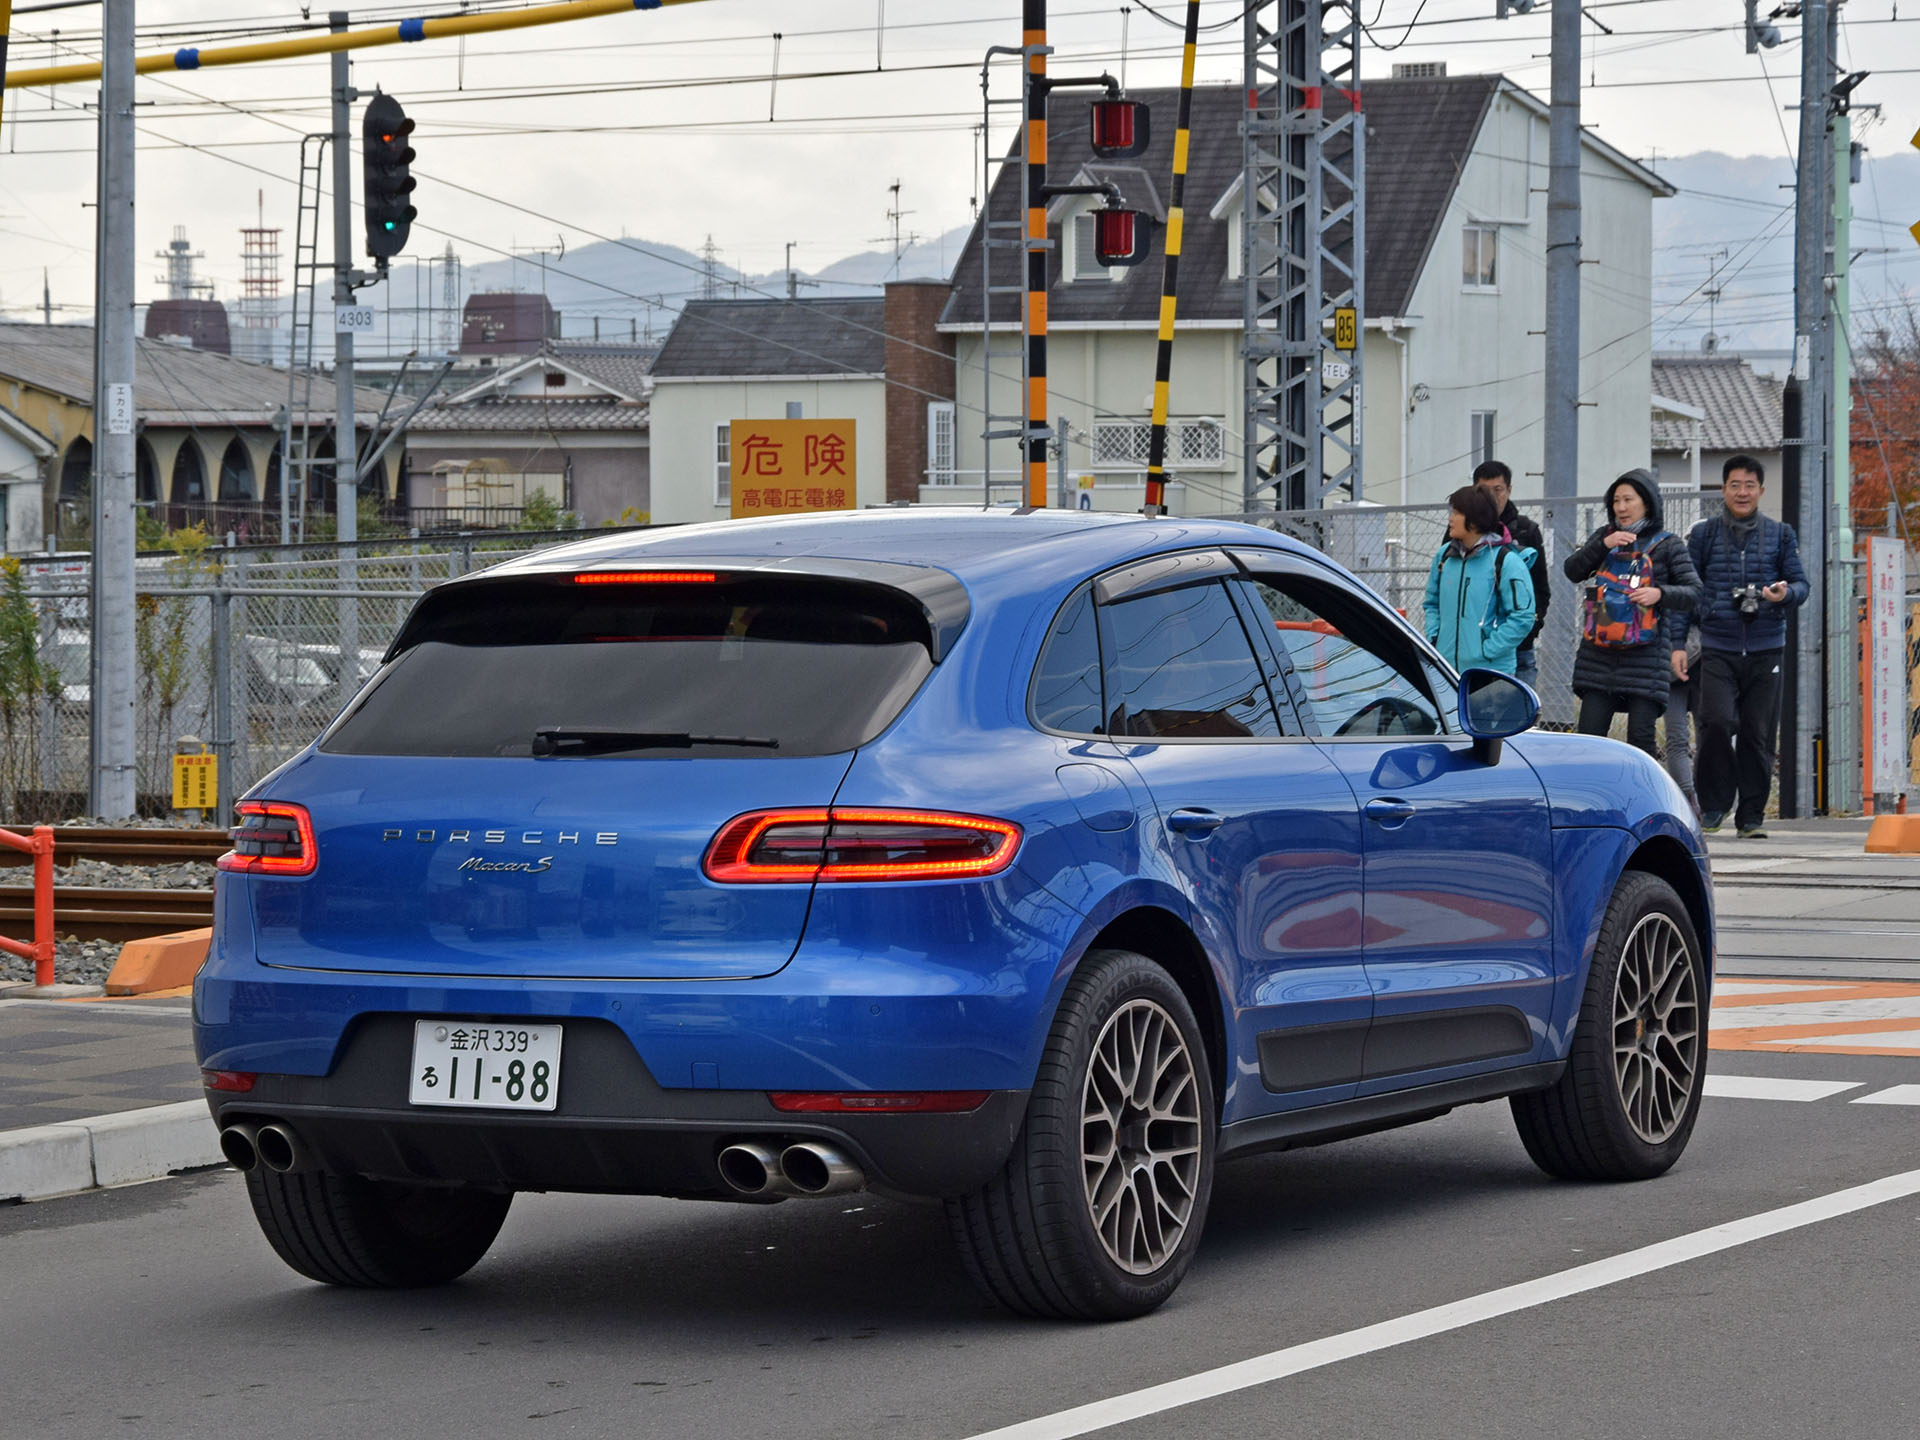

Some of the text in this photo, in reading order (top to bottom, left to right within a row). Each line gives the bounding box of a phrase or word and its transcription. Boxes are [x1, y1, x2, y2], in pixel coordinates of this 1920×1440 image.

[338, 311, 372, 327] 4303
[1338, 316, 1353, 342] 85
[1327, 364, 1345, 378] TEL
[741, 433, 846, 476] 危険
[741, 487, 846, 509] 高電圧電線
[383, 828, 619, 845] PORSCHE
[457, 855, 554, 873] Macan S
[421, 1056, 550, 1103] る 11-88
